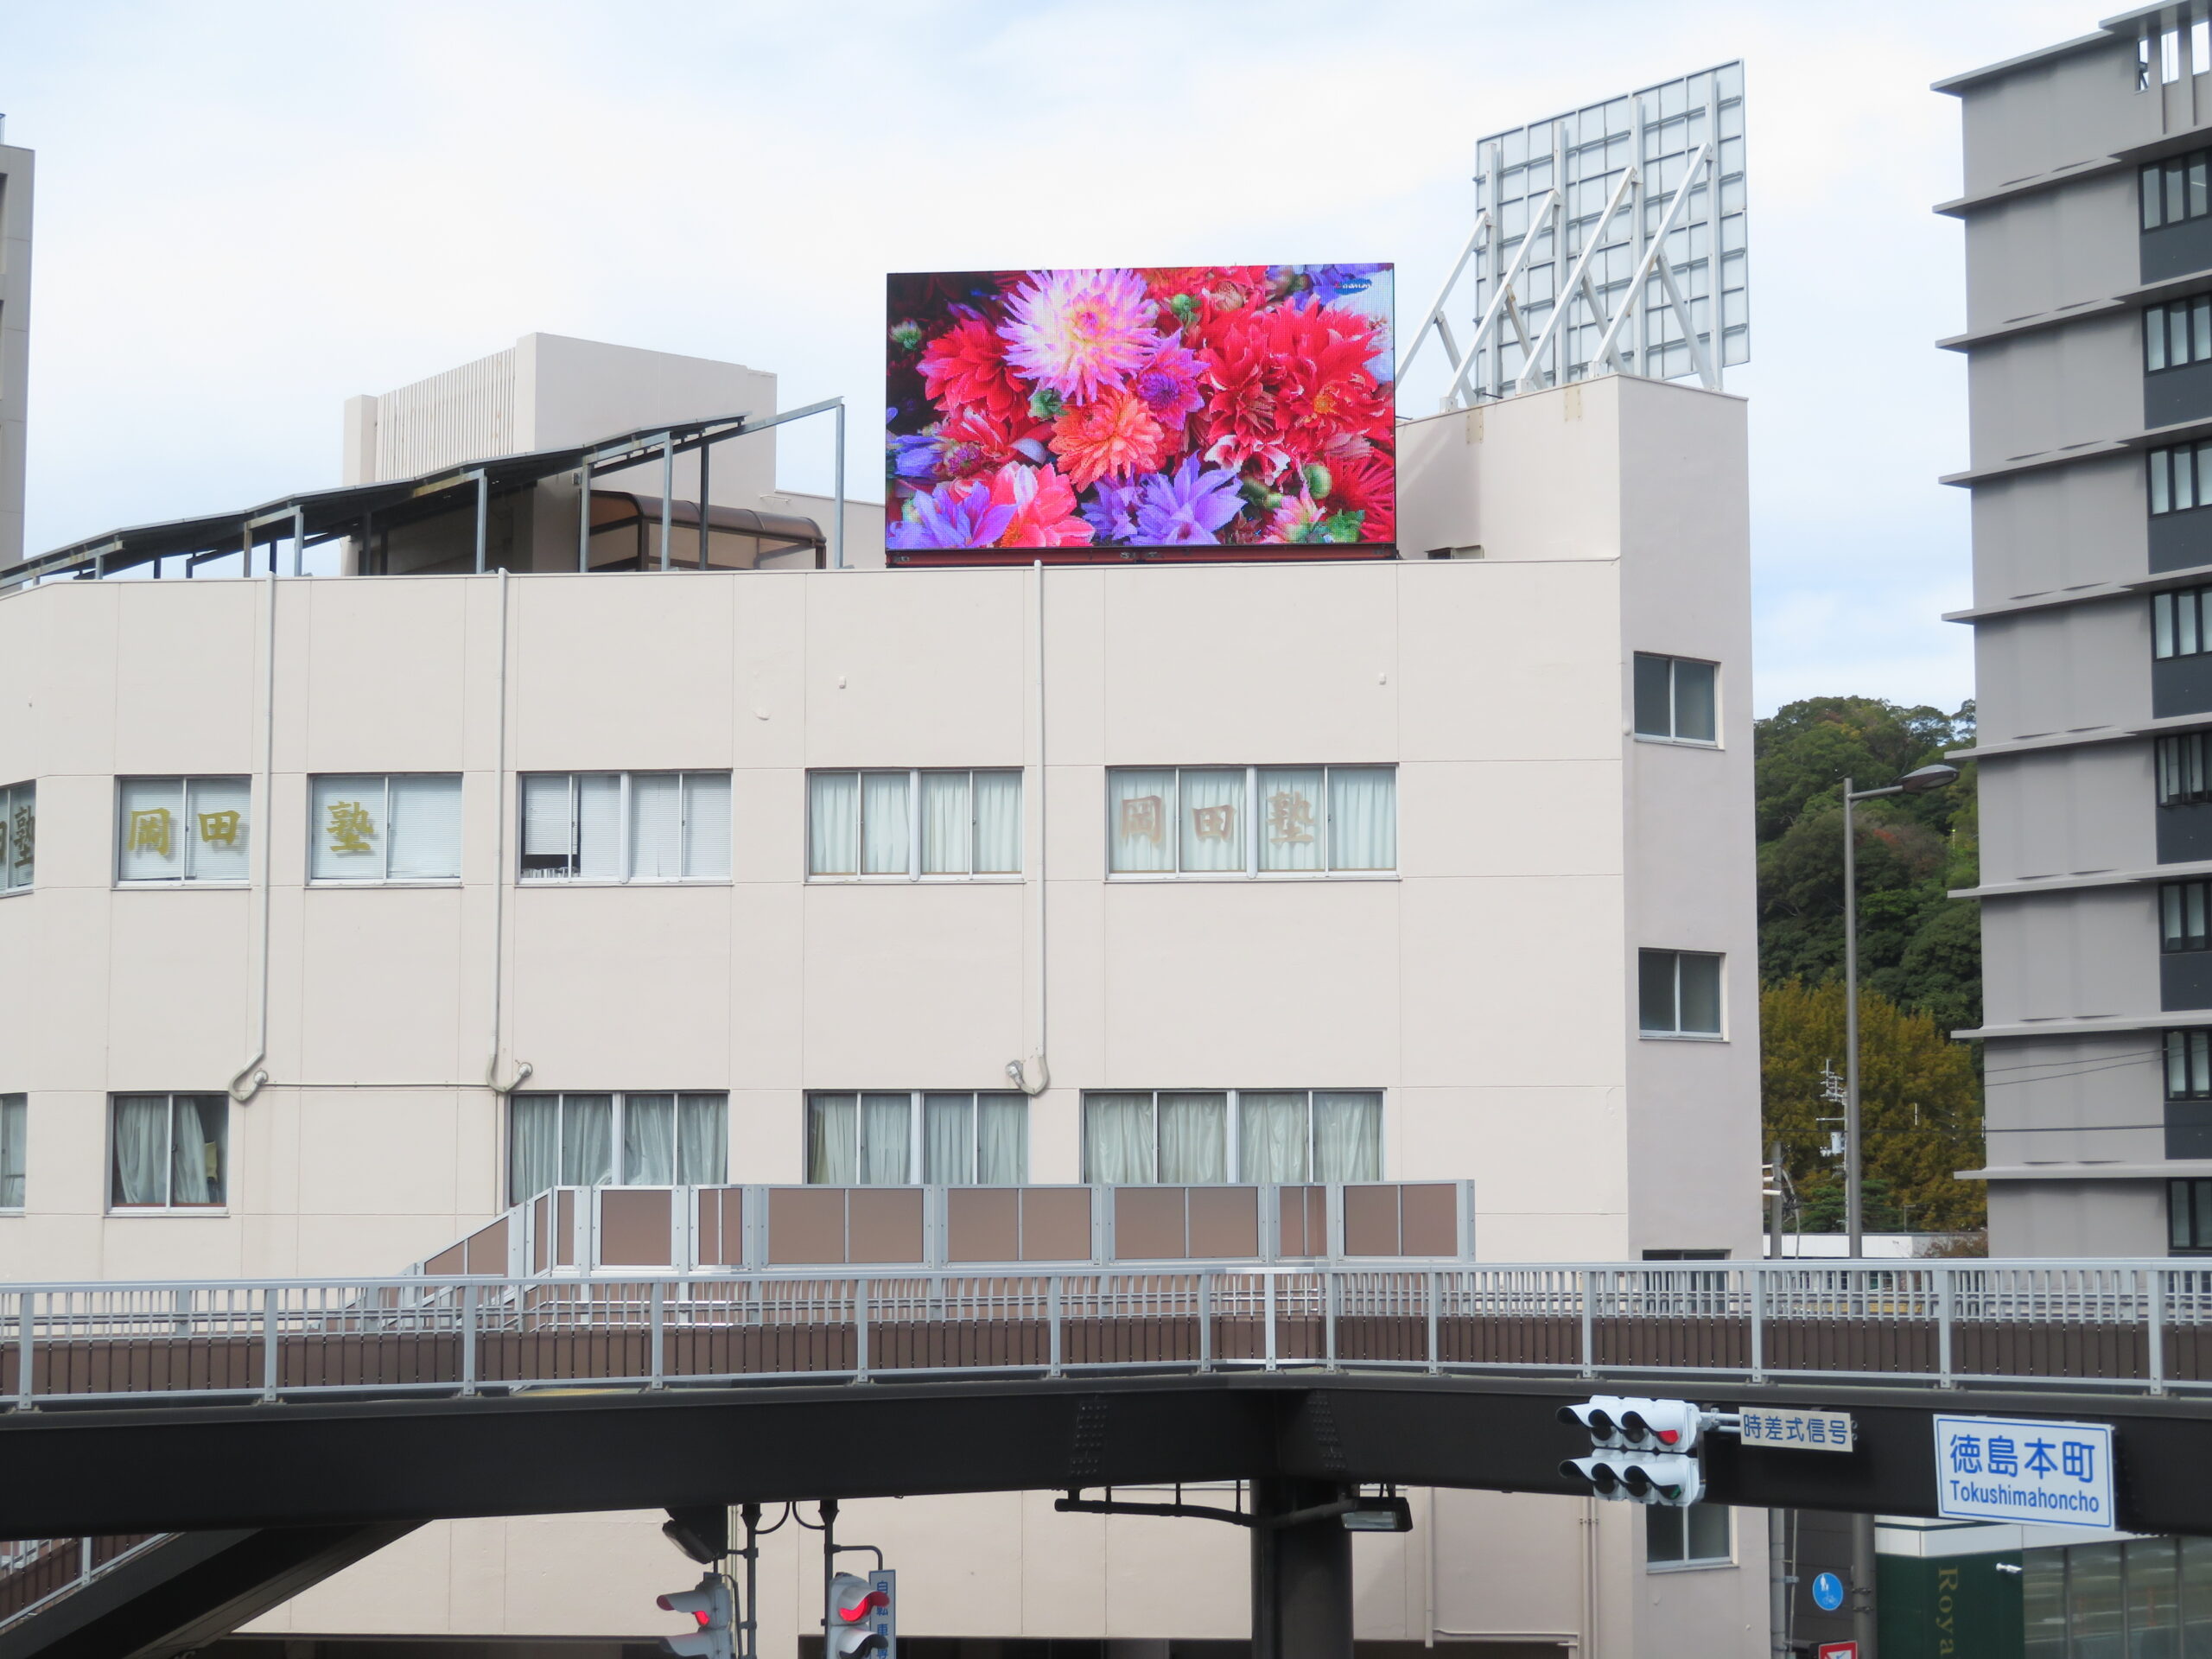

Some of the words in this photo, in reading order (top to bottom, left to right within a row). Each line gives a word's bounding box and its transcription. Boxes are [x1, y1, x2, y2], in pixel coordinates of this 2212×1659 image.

[1743, 1414, 1848, 1445] 時差式信号
[1950, 1434, 2095, 1483] 徳島本町
[1949, 1480, 2100, 1512] Tokushimahoncho
